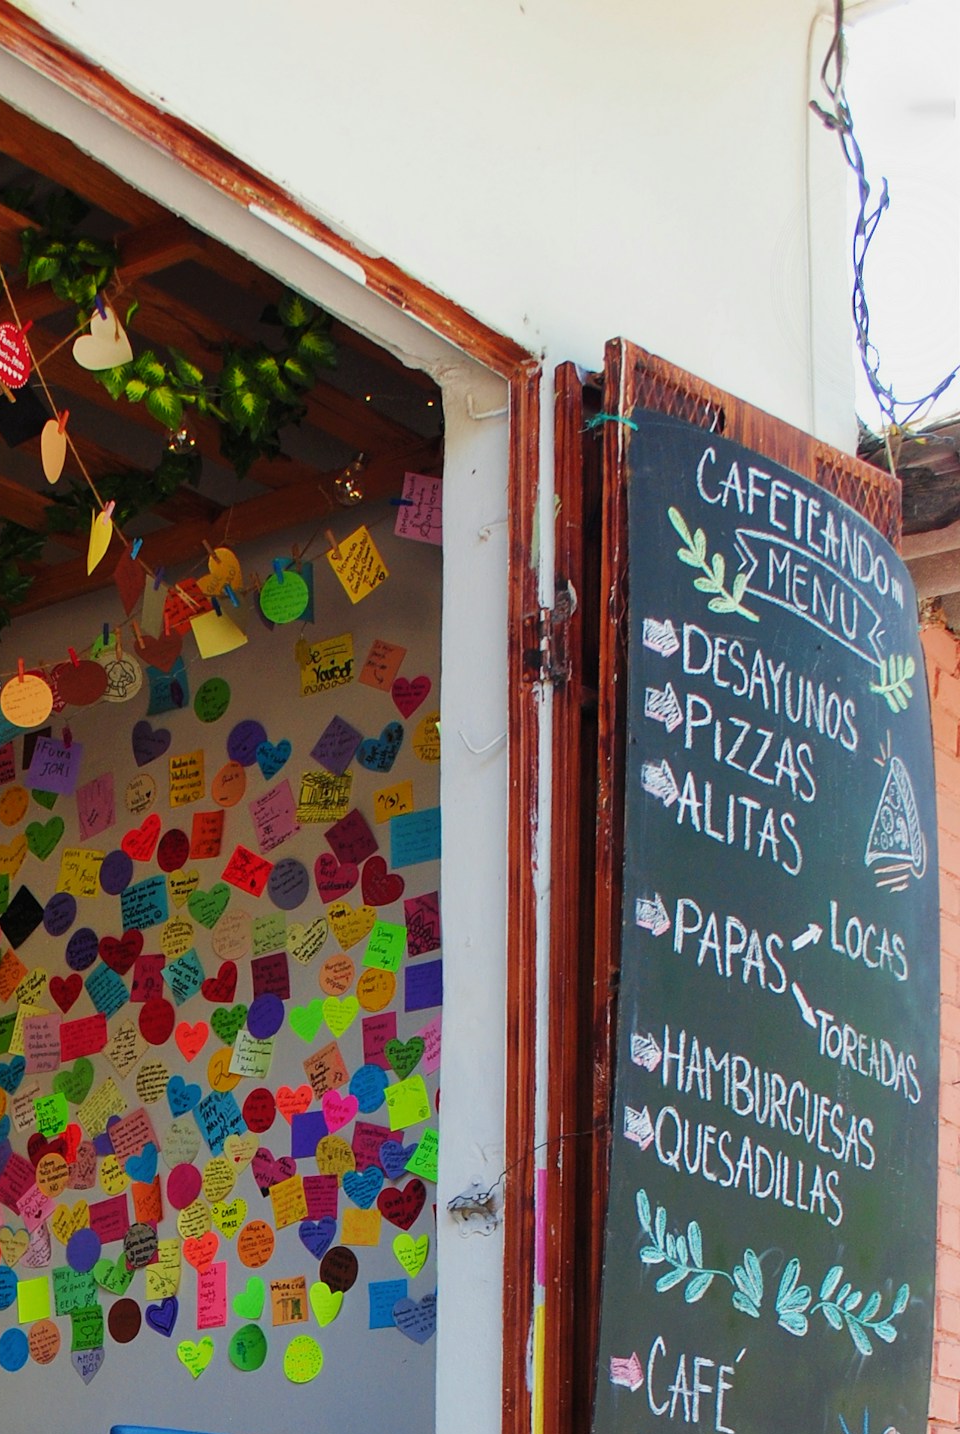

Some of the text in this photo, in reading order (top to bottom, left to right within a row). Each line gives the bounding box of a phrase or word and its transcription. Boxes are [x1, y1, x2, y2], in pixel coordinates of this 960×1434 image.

[697, 447, 890, 596] CAFETEANDO
[768, 548, 859, 641] MENU
[682, 622, 859, 753] DESAYUNOS
[684, 693, 818, 803] PIZZAS
[676, 771, 805, 877] ALITAS
[673, 898, 909, 995] PAPAS LOCAS
[661, 1023, 876, 1171] HAMBURGUESAS
[815, 1008, 923, 1105] TOREADAS
[654, 1105, 844, 1227] QUESADILLAS
[646, 1335, 747, 1434] CAFÉ
